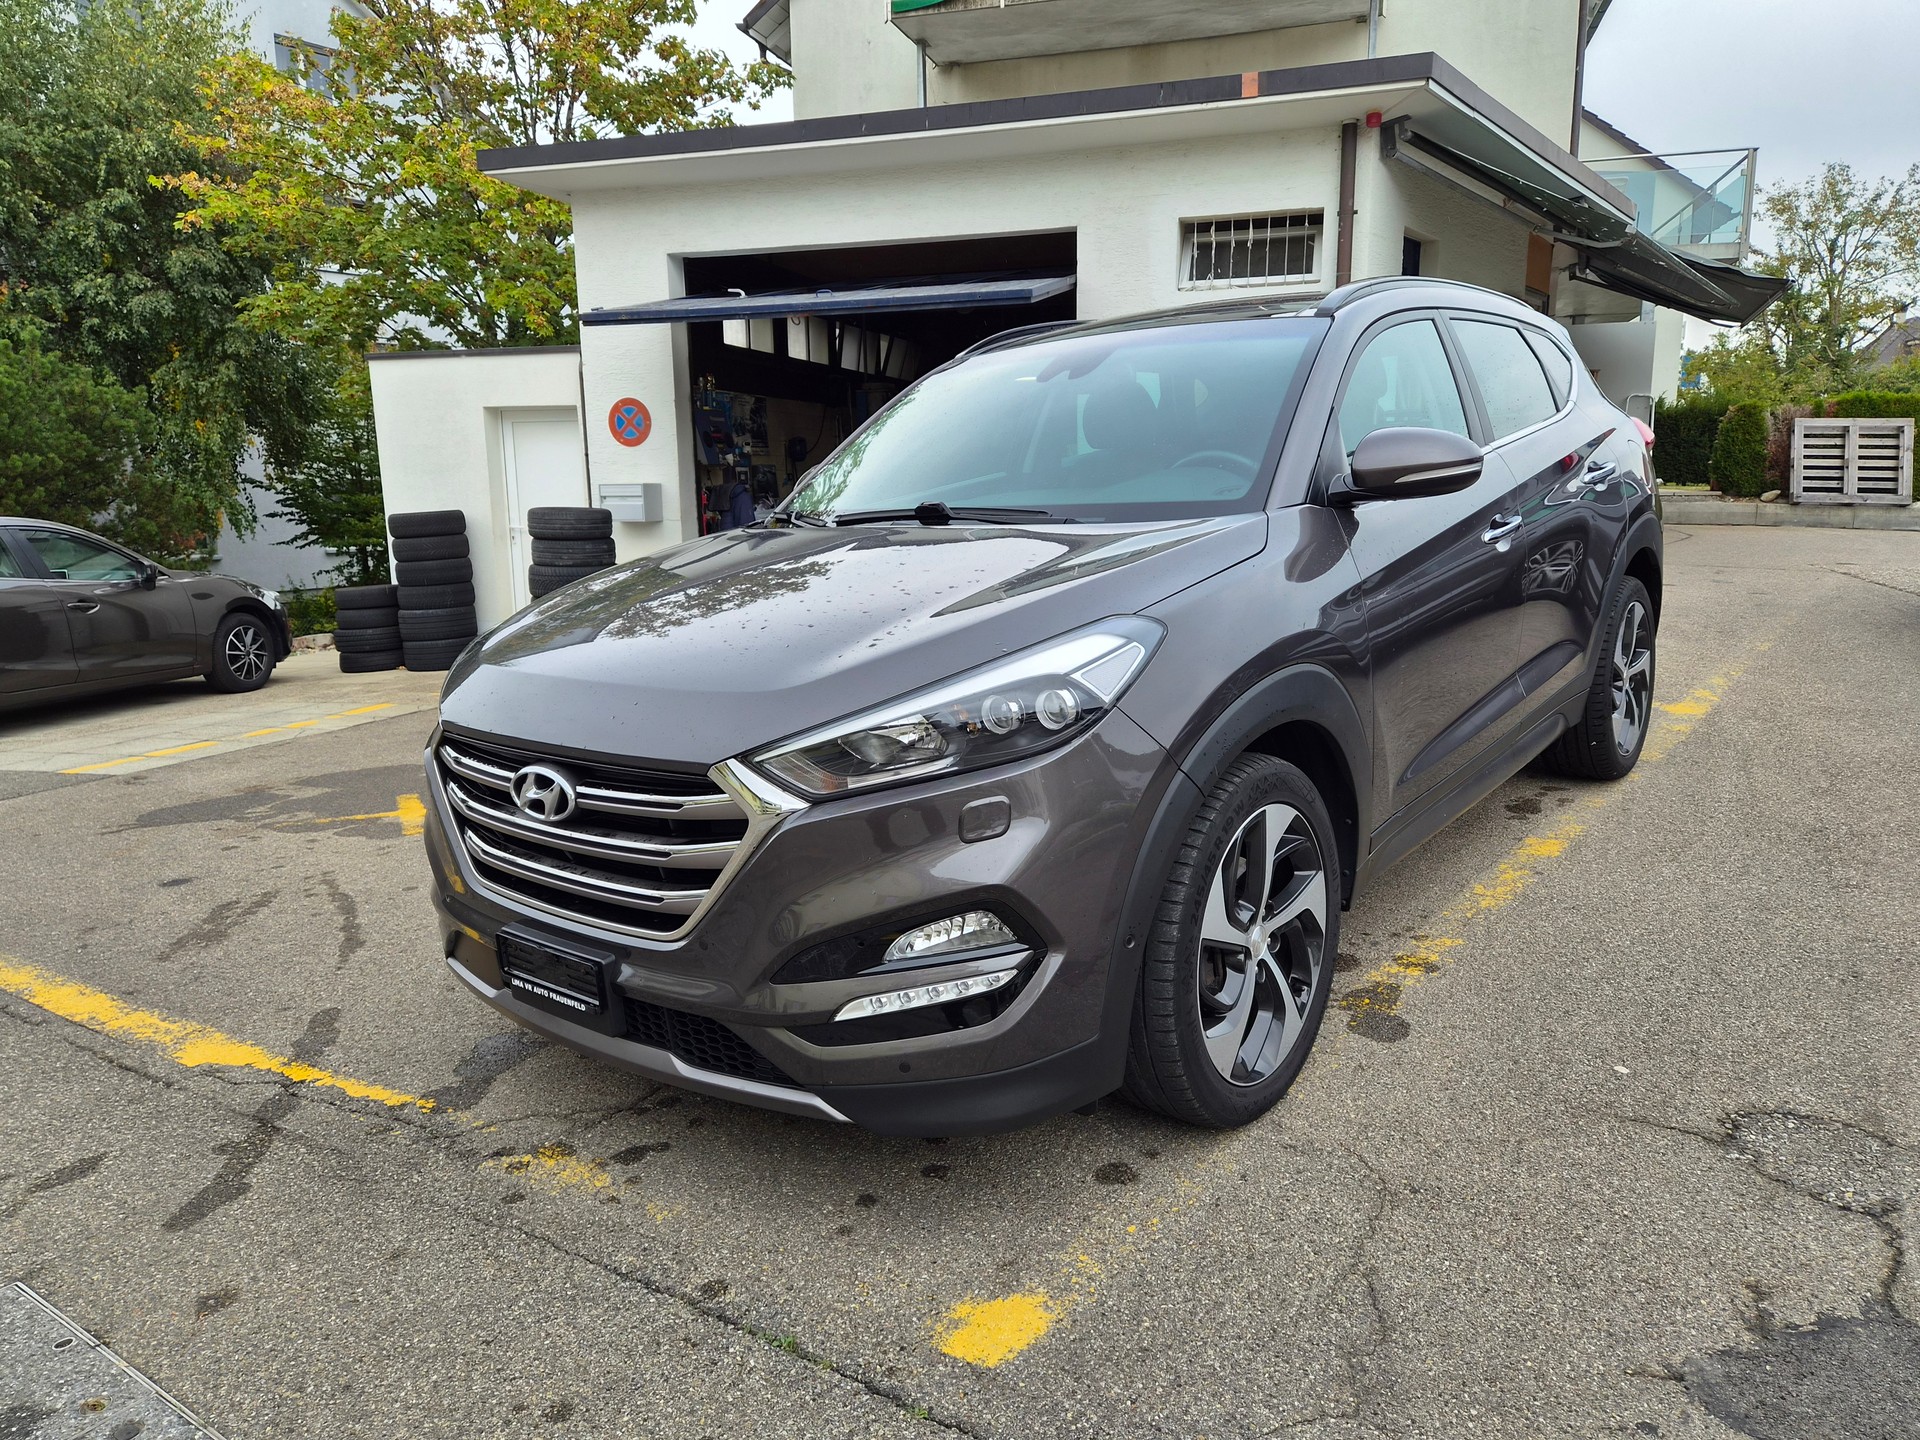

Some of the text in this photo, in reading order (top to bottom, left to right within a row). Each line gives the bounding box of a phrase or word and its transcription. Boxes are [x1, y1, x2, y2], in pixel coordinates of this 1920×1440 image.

[1214, 835, 1224, 851] R
[524, 983, 532, 992] VR
[533, 985, 549, 998] AUTO
[549, 992, 586, 1011] FRAUENFELD
